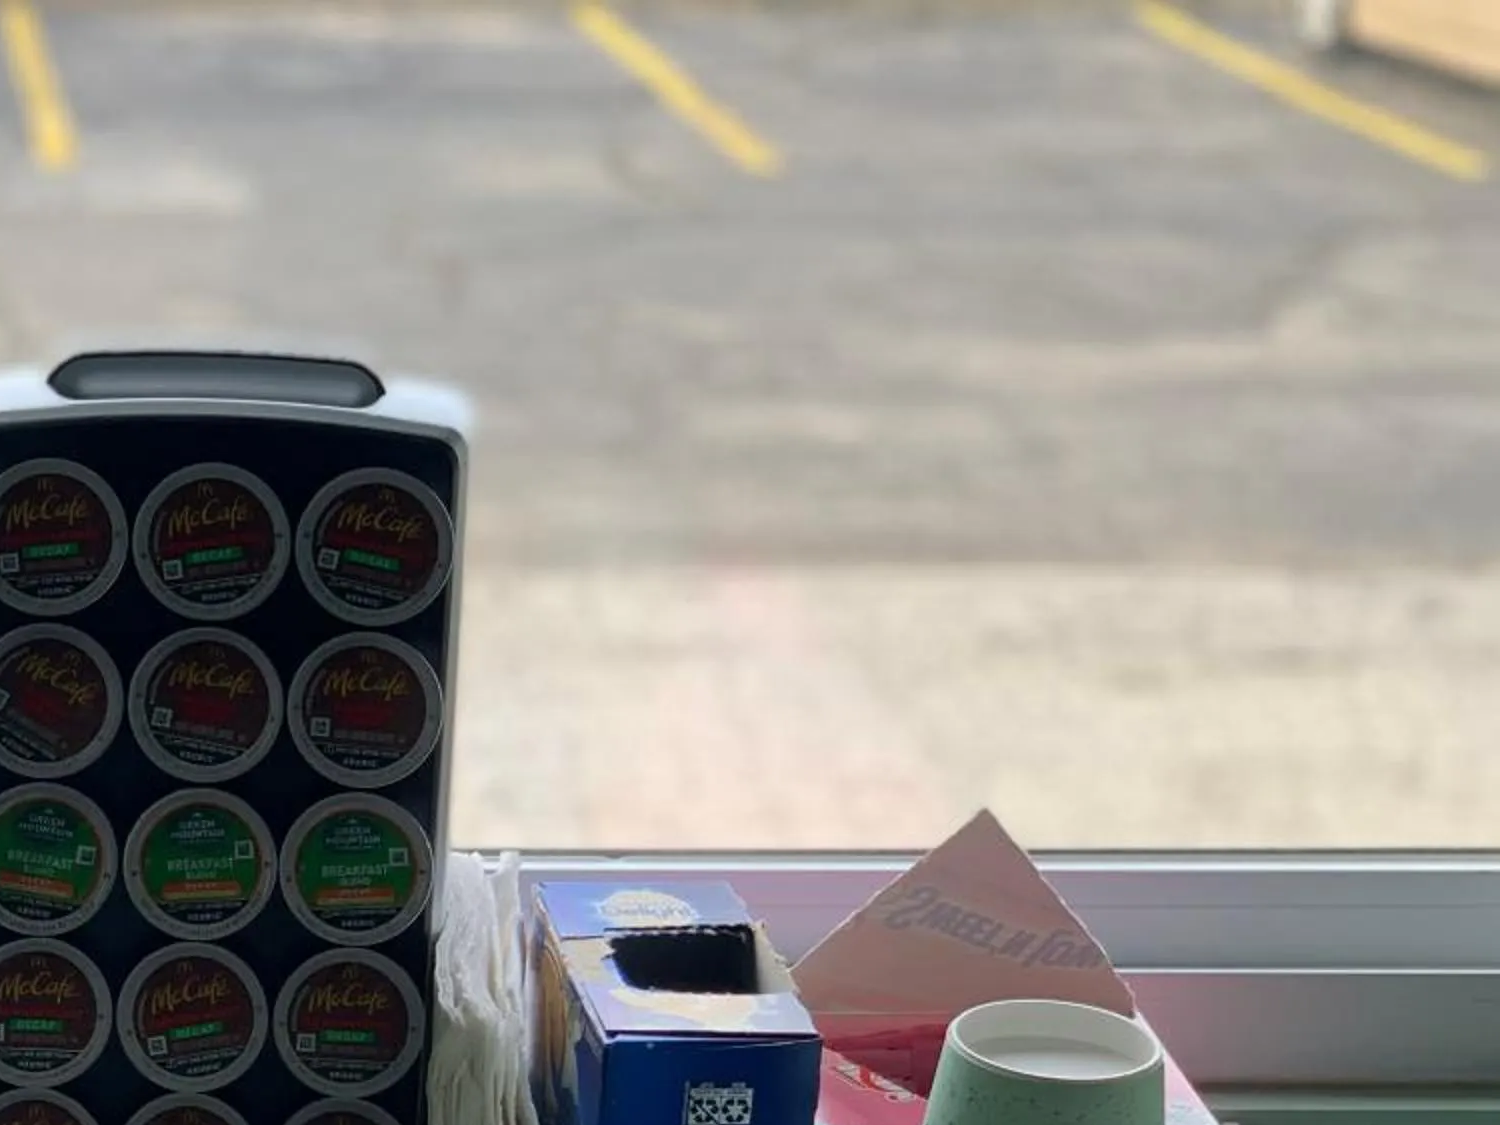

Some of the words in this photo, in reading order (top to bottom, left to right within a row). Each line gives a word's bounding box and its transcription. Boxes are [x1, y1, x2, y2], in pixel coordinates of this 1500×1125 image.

[7, 849, 73, 870] BREAKFAST
[167, 856, 234, 872] BREAKFAST
[321, 864, 388, 878] BREAKFAST
